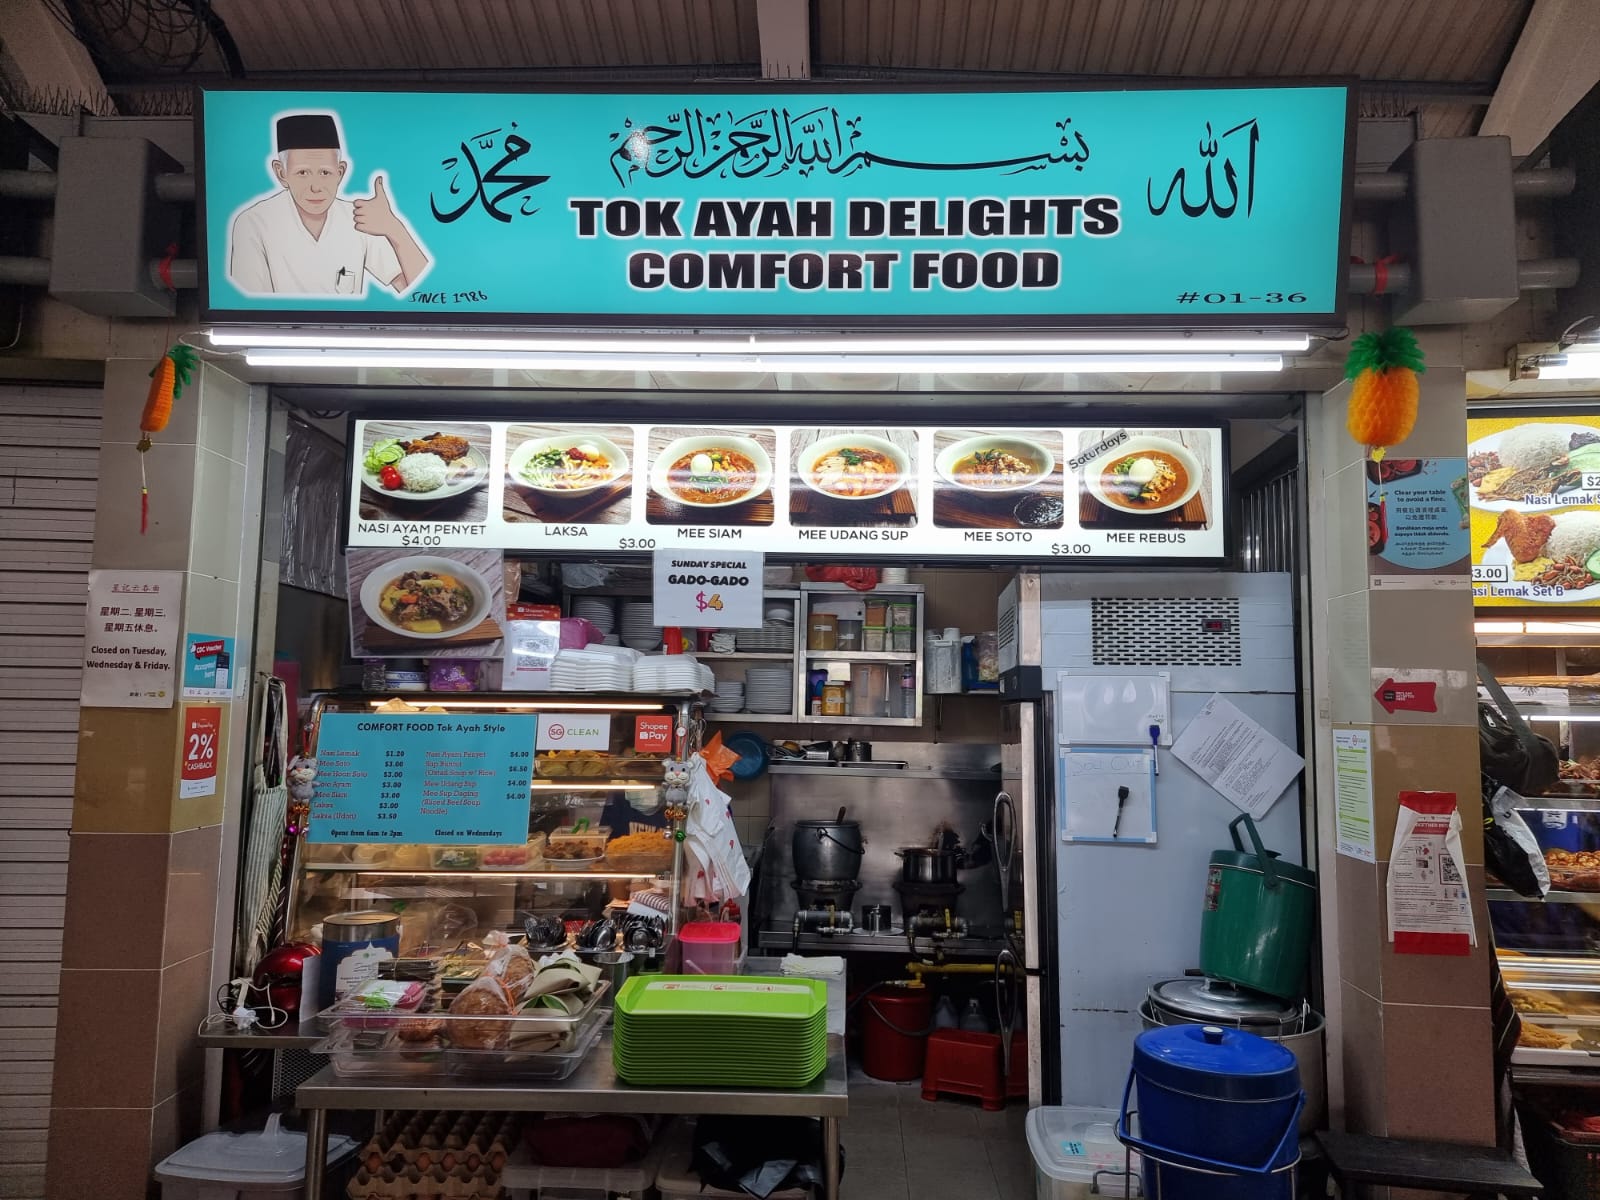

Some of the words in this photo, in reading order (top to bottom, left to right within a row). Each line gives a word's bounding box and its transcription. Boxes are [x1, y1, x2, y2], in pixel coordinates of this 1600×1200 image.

[1147, 117, 1260, 219] الله
[572, 200, 682, 236] TOK
[694, 200, 832, 236] AYAH
[849, 199, 1119, 236] DELIGHTS
[629, 253, 898, 289] COMFORT
[912, 252, 1059, 288] FOOD
[408, 292, 447, 304] SINCE
[453, 291, 488, 303] 1986
[1176, 291, 1307, 304] #01-36
[1069, 432, 1127, 470] Saturdays
[1525, 494, 1551, 505] Nasi
[1555, 493, 1593, 504] Lemak
[358, 523, 389, 533] NASI
[392, 523, 431, 534] AYAM
[434, 524, 487, 535] PENYET
[544, 526, 589, 537] LAKSA
[677, 528, 706, 539] MEE
[708, 528, 742, 539] SIAM
[402, 535, 442, 546] $4.00
[798, 529, 827, 540] MEE
[829, 529, 878, 541] UDANG
[881, 530, 909, 541] SUP
[963, 531, 992, 542] MEE
[995, 531, 1033, 543] SOTO
[1106, 532, 1135, 543] MEE
[1139, 532, 1186, 544] REBUS
[618, 538, 656, 549] $3.00
[1050, 543, 1091, 555] $3.00
[671, 560, 709, 568] SUNDAY
[710, 561, 747, 569] SPECIAL
[1472, 568, 1502, 578] 3.00
[668, 574, 749, 586] GADO-GADO
[1472, 585, 1487, 596] asi
[1491, 586, 1529, 596] Lemak
[1533, 586, 1553, 596] Set
[1556, 586, 1564, 596] B
[696, 590, 724, 612] $4
[91, 646, 117, 654] Closed
[132, 646, 167, 656] Tuesday,
[86, 660, 133, 670] Wednesday
[135, 661, 141, 669] &
[143, 661, 171, 670] Friday.
[357, 723, 403, 731] COMFORT
[406, 723, 434, 731] FOOD
[437, 723, 453, 731] Tok
[455, 724, 481, 733] Ayah
[550, 727, 563, 736] SG
[567, 728, 600, 736] CLEAN
[640, 721, 668, 731] Shopee
[649, 732, 668, 742] Pay
[188, 733, 214, 760] 2%
[187, 761, 213, 771] CASHBACK
[434, 829, 454, 837] Closed
[466, 829, 503, 838] Wednesdays
